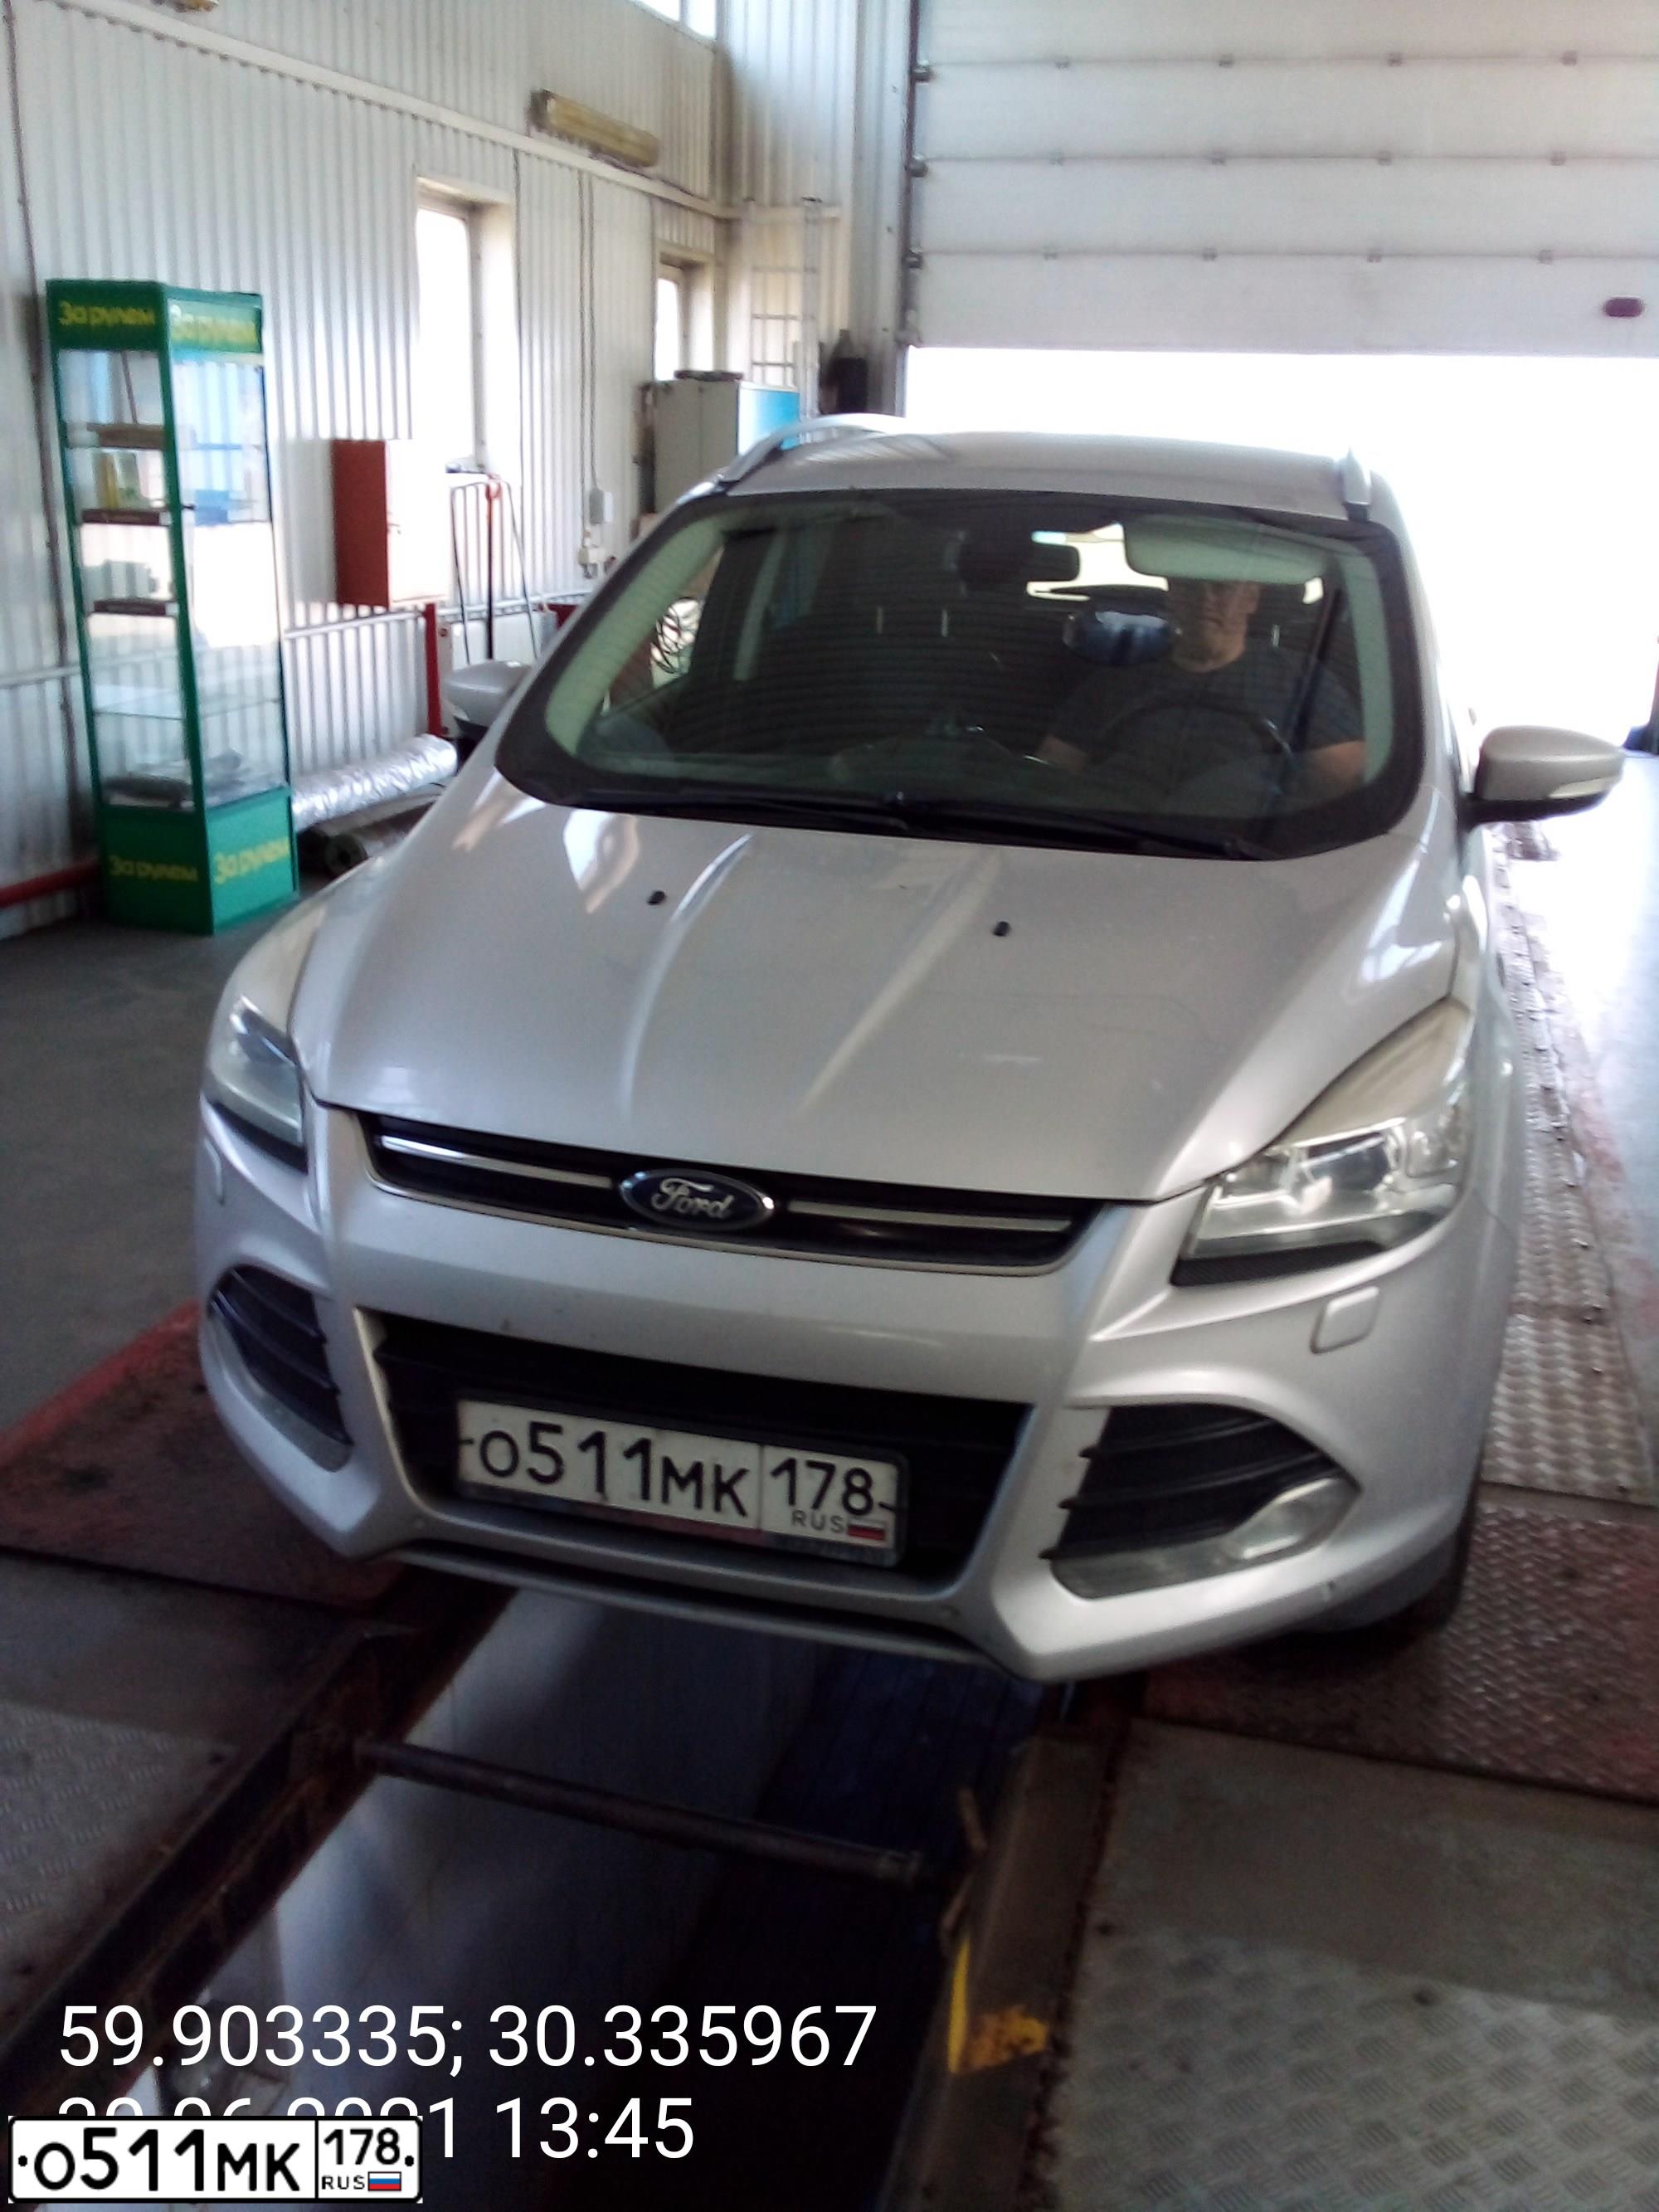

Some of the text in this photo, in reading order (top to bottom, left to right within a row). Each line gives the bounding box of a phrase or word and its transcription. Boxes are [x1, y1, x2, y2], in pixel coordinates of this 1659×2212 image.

[650, 1177, 735, 1219] Ford
[770, 1458, 874, 1517] 178
[791, 1510, 845, 1534] RUS
